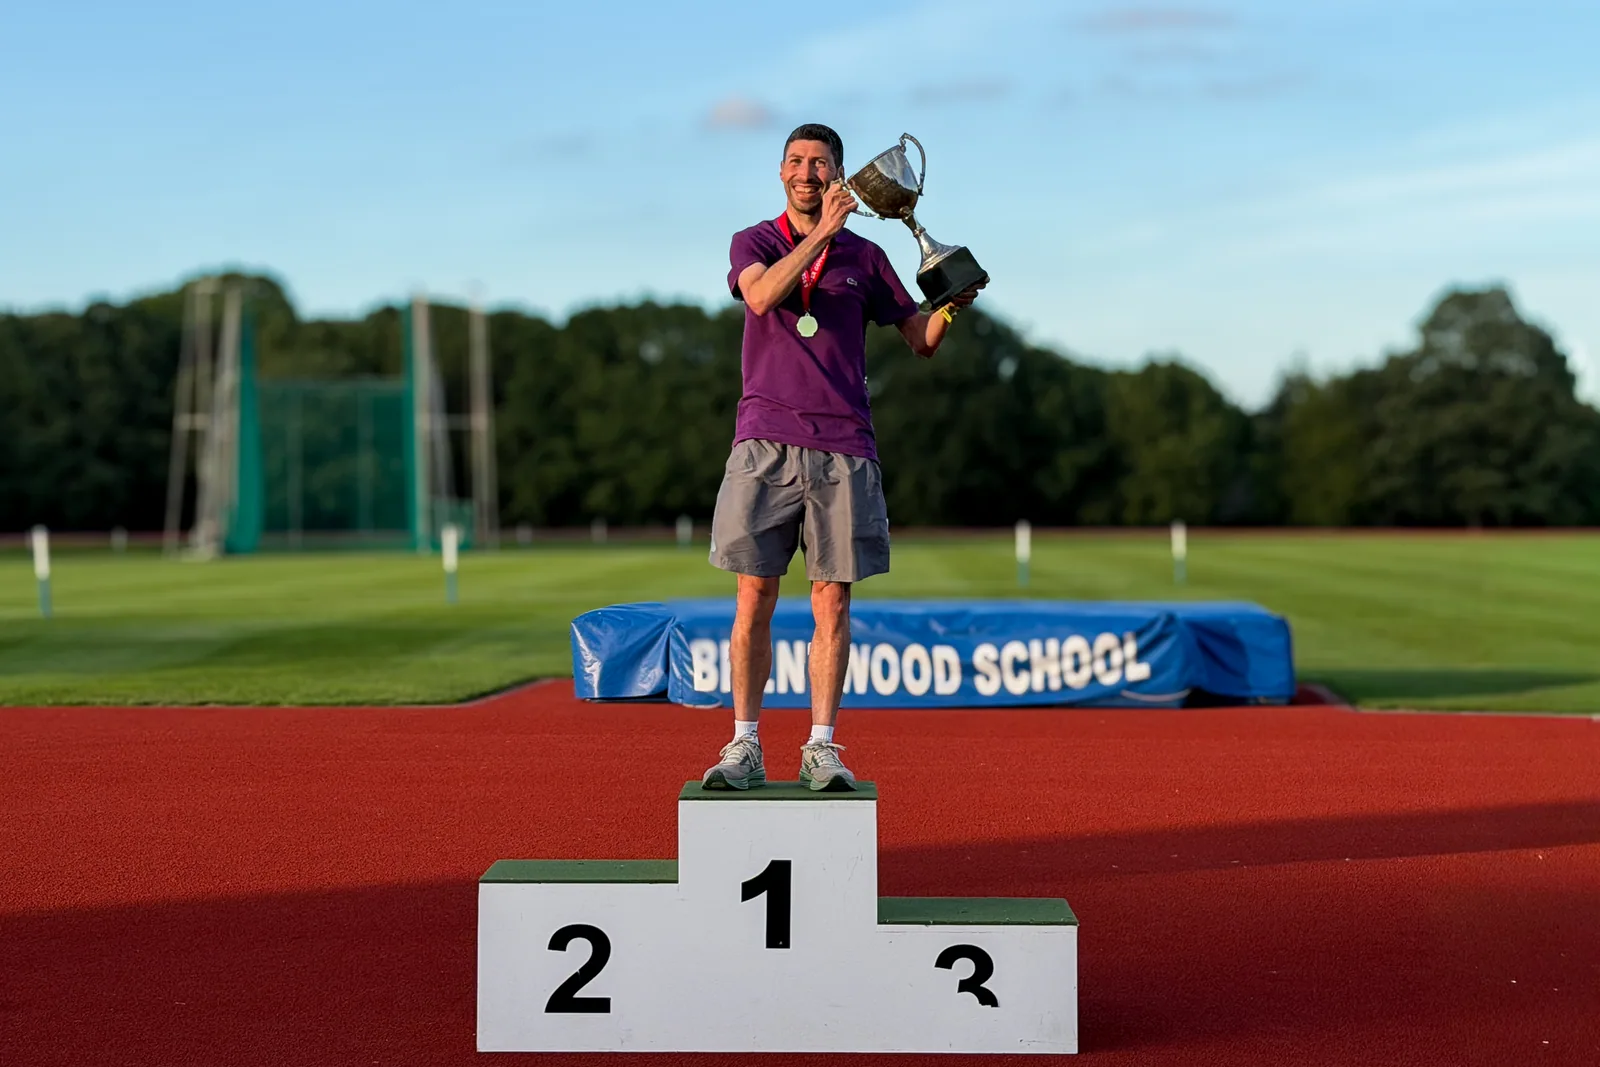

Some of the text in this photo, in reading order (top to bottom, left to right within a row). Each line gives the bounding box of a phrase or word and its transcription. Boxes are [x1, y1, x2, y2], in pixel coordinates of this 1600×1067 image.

[690, 631, 1151, 697] BNWOOD SCHOOL
[741, 860, 791, 949] 1
[545, 924, 611, 1014] 2
